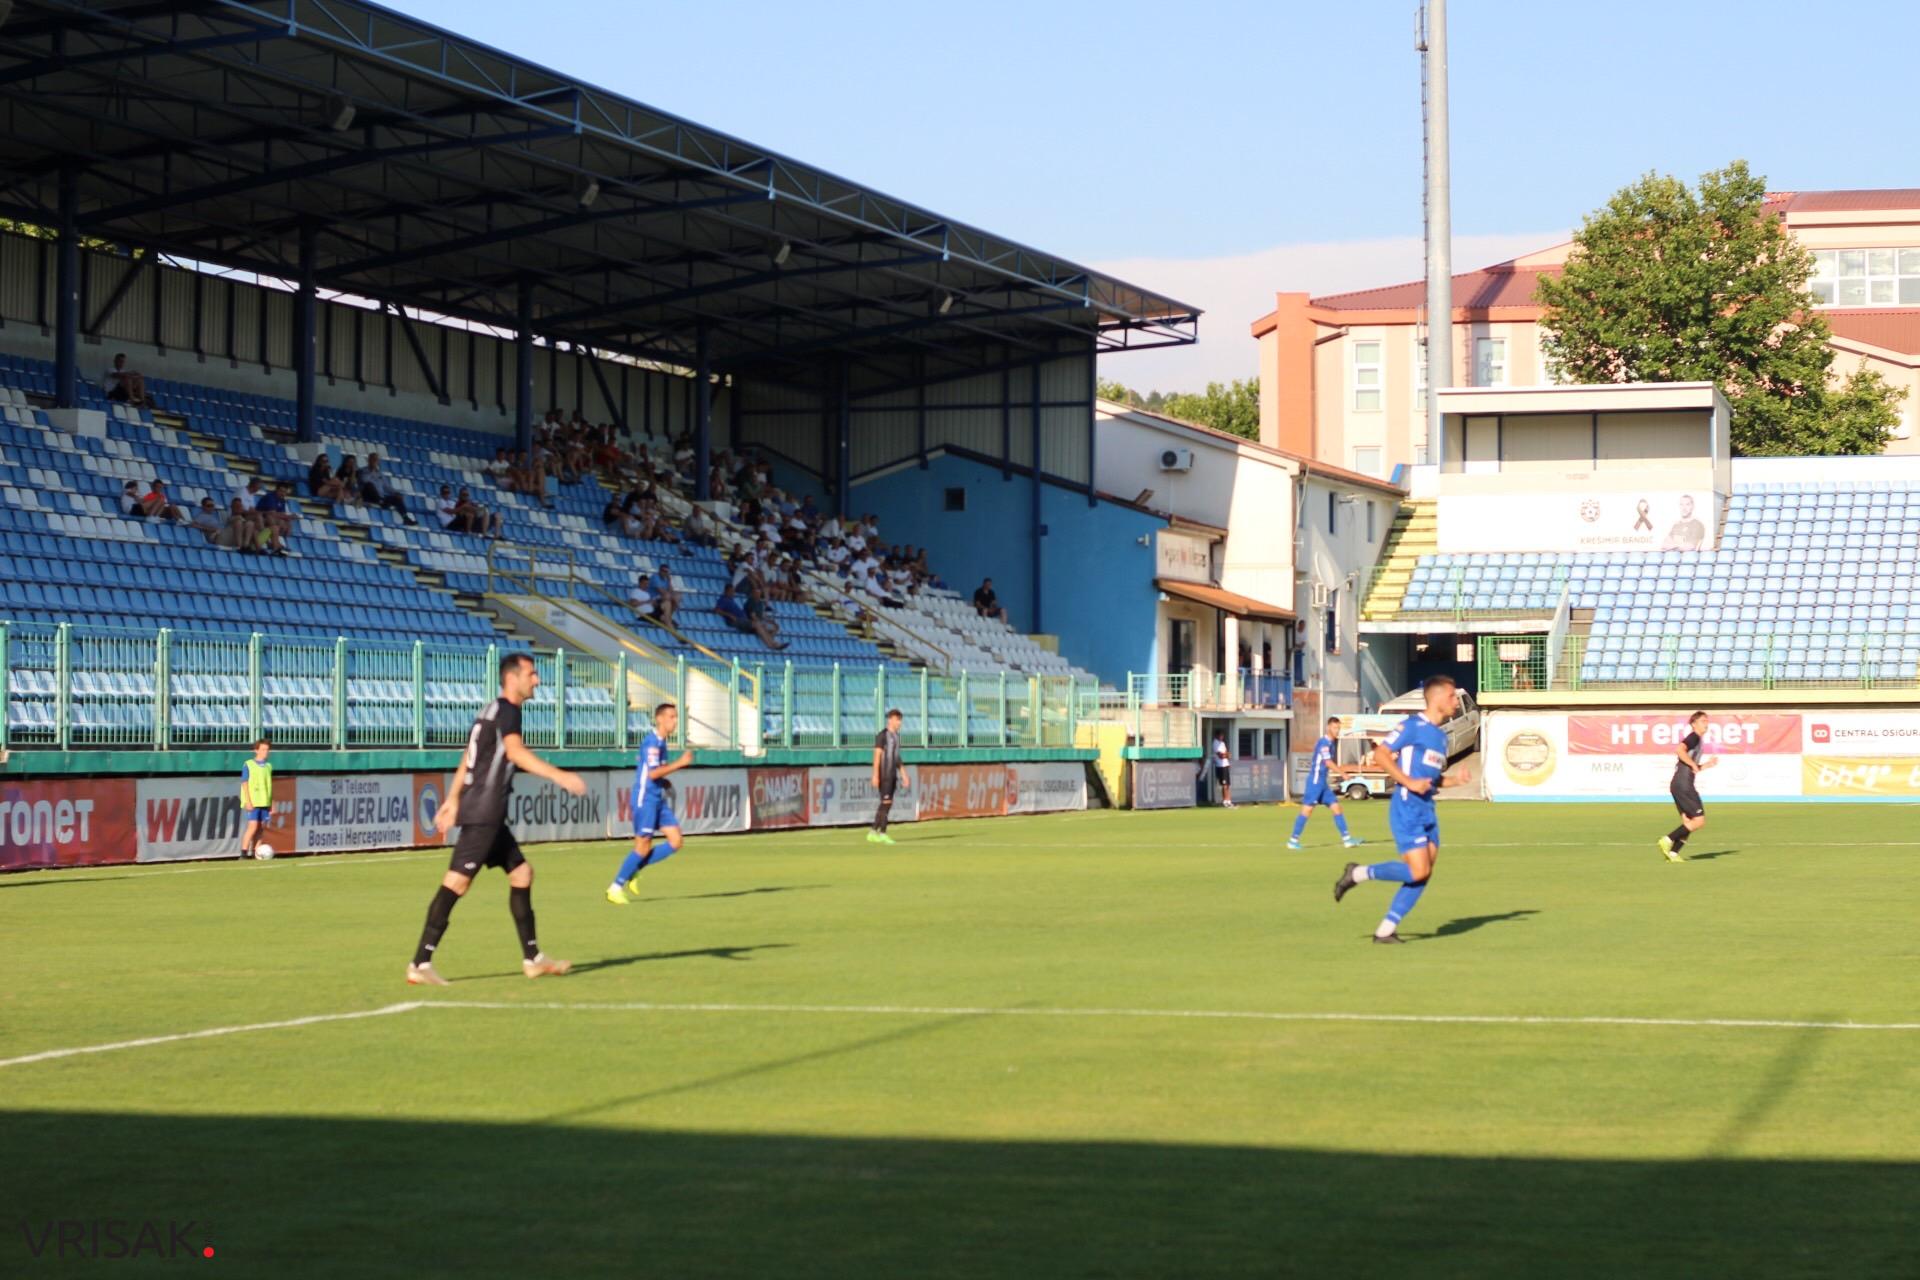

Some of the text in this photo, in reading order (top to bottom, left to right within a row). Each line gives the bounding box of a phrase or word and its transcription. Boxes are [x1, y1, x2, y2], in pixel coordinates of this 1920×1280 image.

[1611, 723, 1648, 744] HT
[1834, 729, 1879, 737] CENTRAL
[301, 796, 409, 826] PREMIJER LIGA
[308, 830, 337, 847] Bosne
[345, 827, 402, 846] Hercegovine
